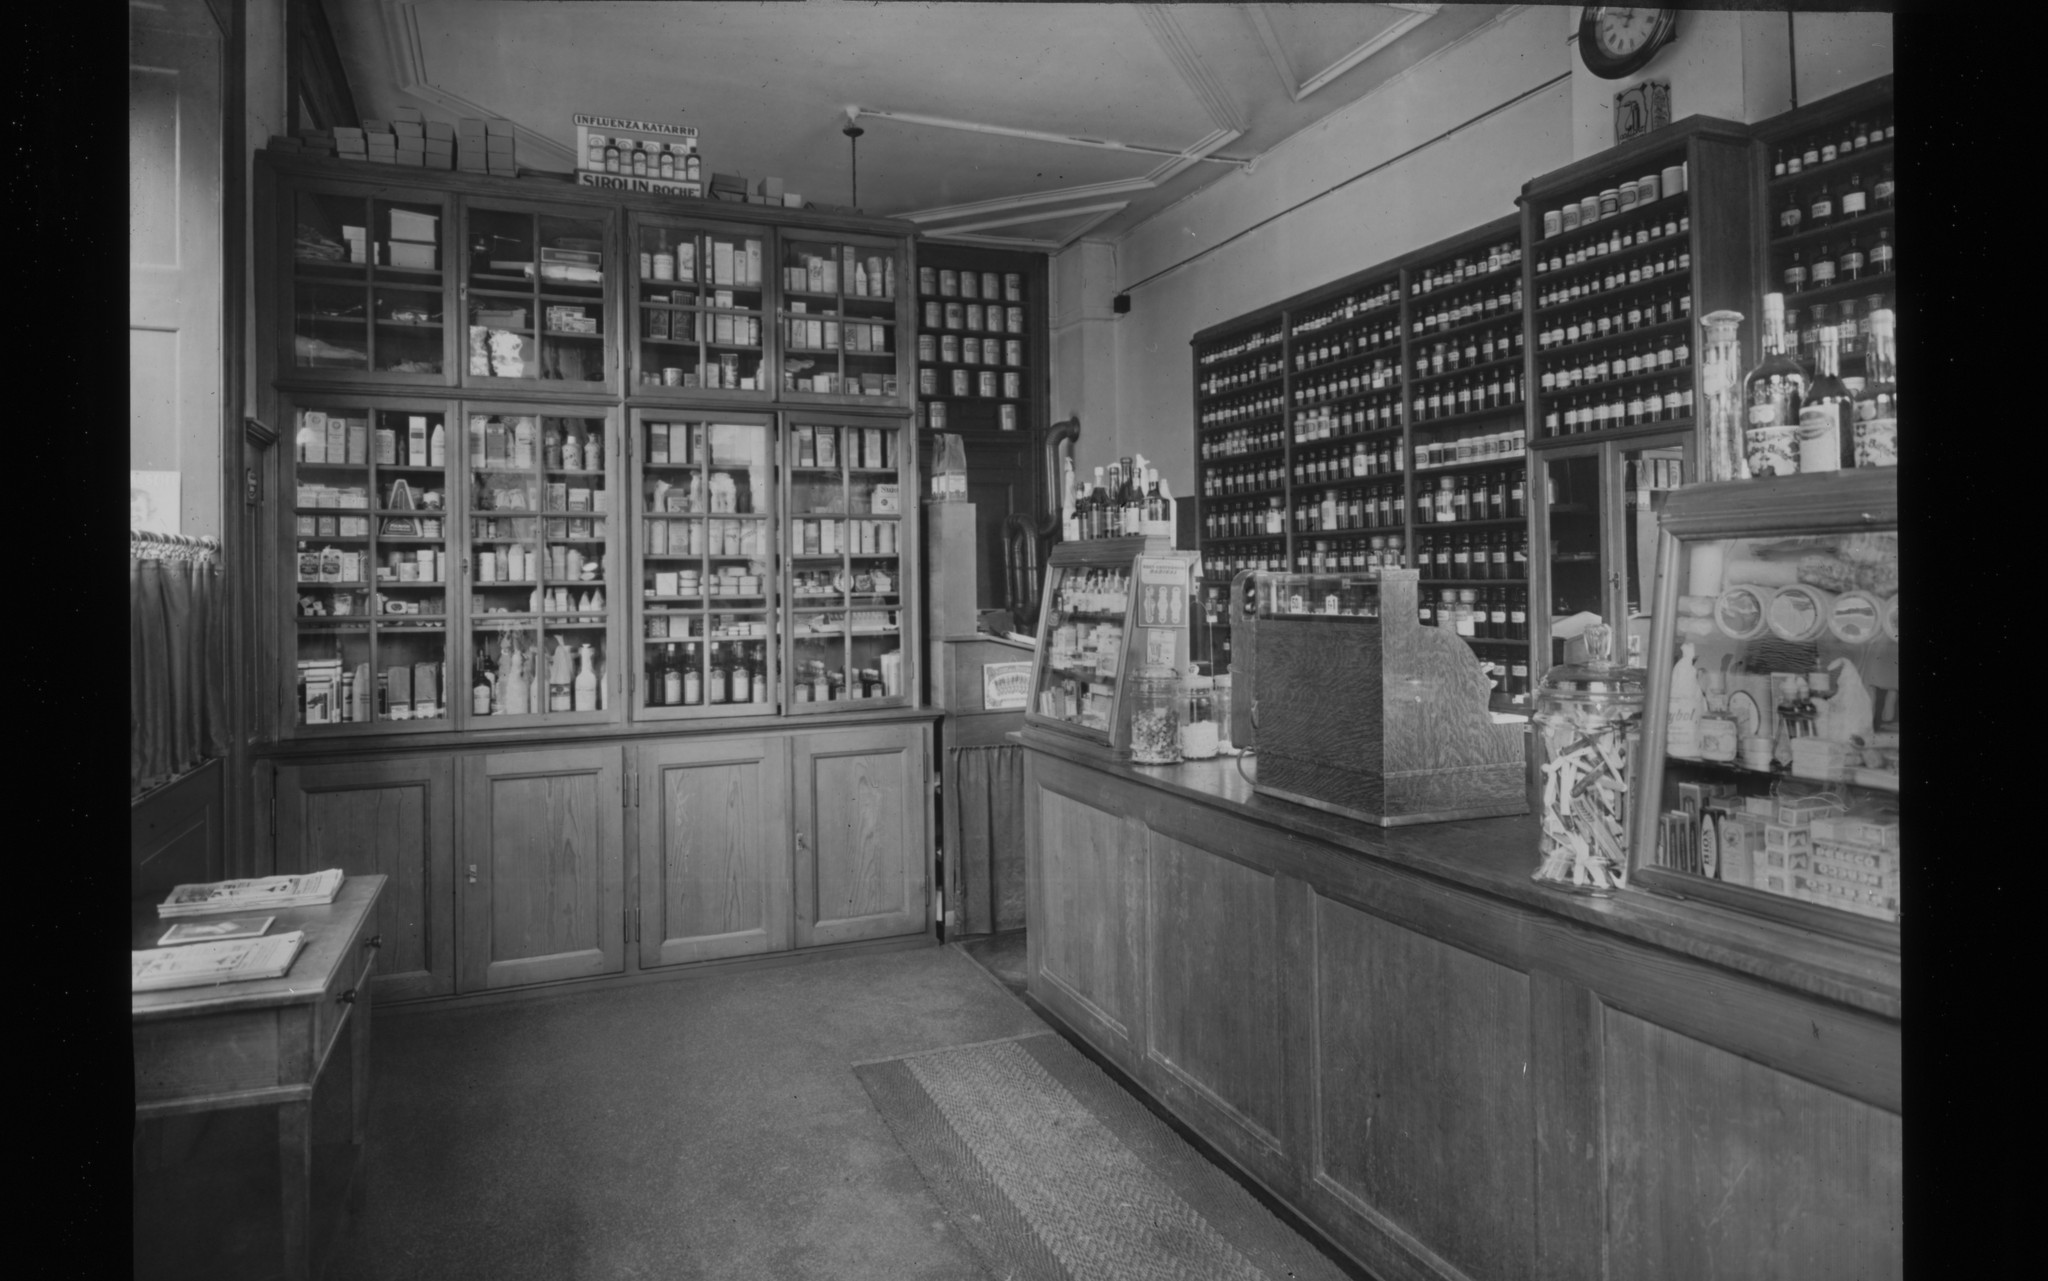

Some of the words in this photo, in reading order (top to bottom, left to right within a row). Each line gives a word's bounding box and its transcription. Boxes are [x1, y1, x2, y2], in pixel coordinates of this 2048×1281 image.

[577, 115, 639, 130] INFLUENZA
[642, 123, 696, 136] KATARRH
[583, 174, 649, 193] SIROLIN
[653, 184, 700, 198] ROCHE
